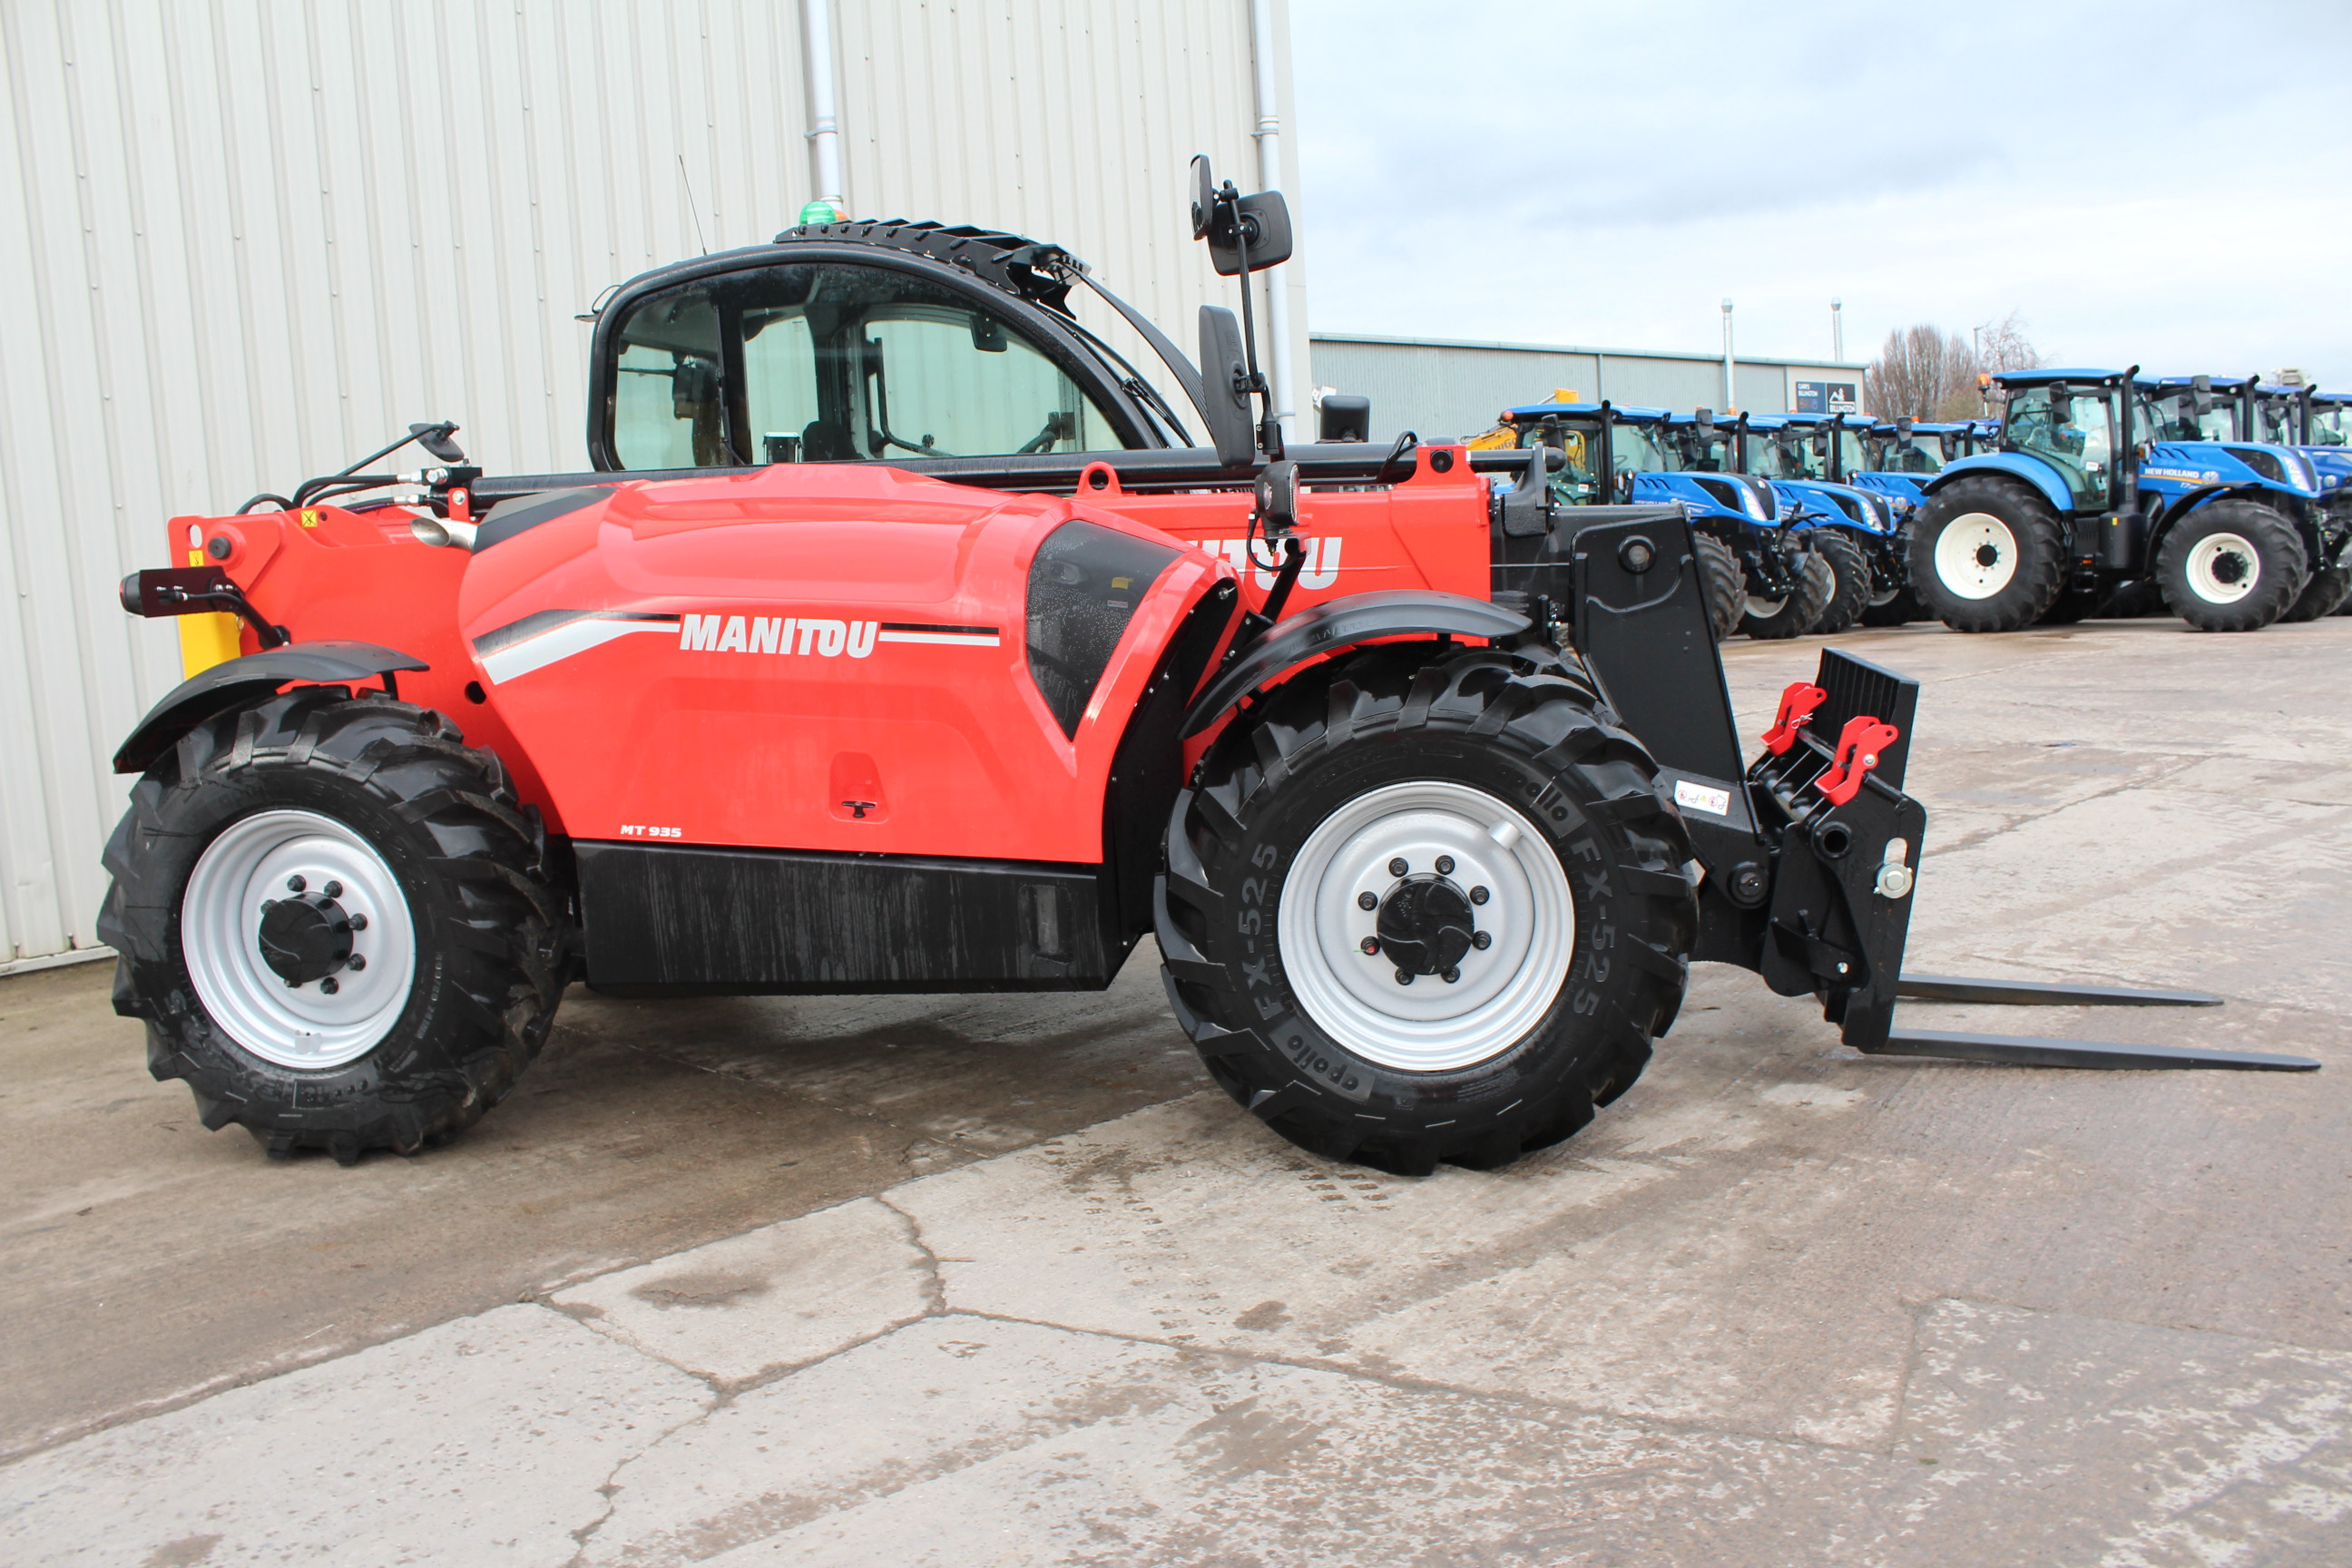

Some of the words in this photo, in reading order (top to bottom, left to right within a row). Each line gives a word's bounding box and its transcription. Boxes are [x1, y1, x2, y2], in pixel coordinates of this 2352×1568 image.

[2144, 467, 2162, 475] NEW
[2162, 468, 2200, 479] HOLLAND
[679, 613, 878, 659] MANITOU
[620, 824, 646, 836] MT
[649, 826, 682, 838] 935
[1238, 842, 1284, 1021] FX-525
[1571, 838, 1617, 1016] FX-525
[1288, 1034, 1359, 1092] apollo
